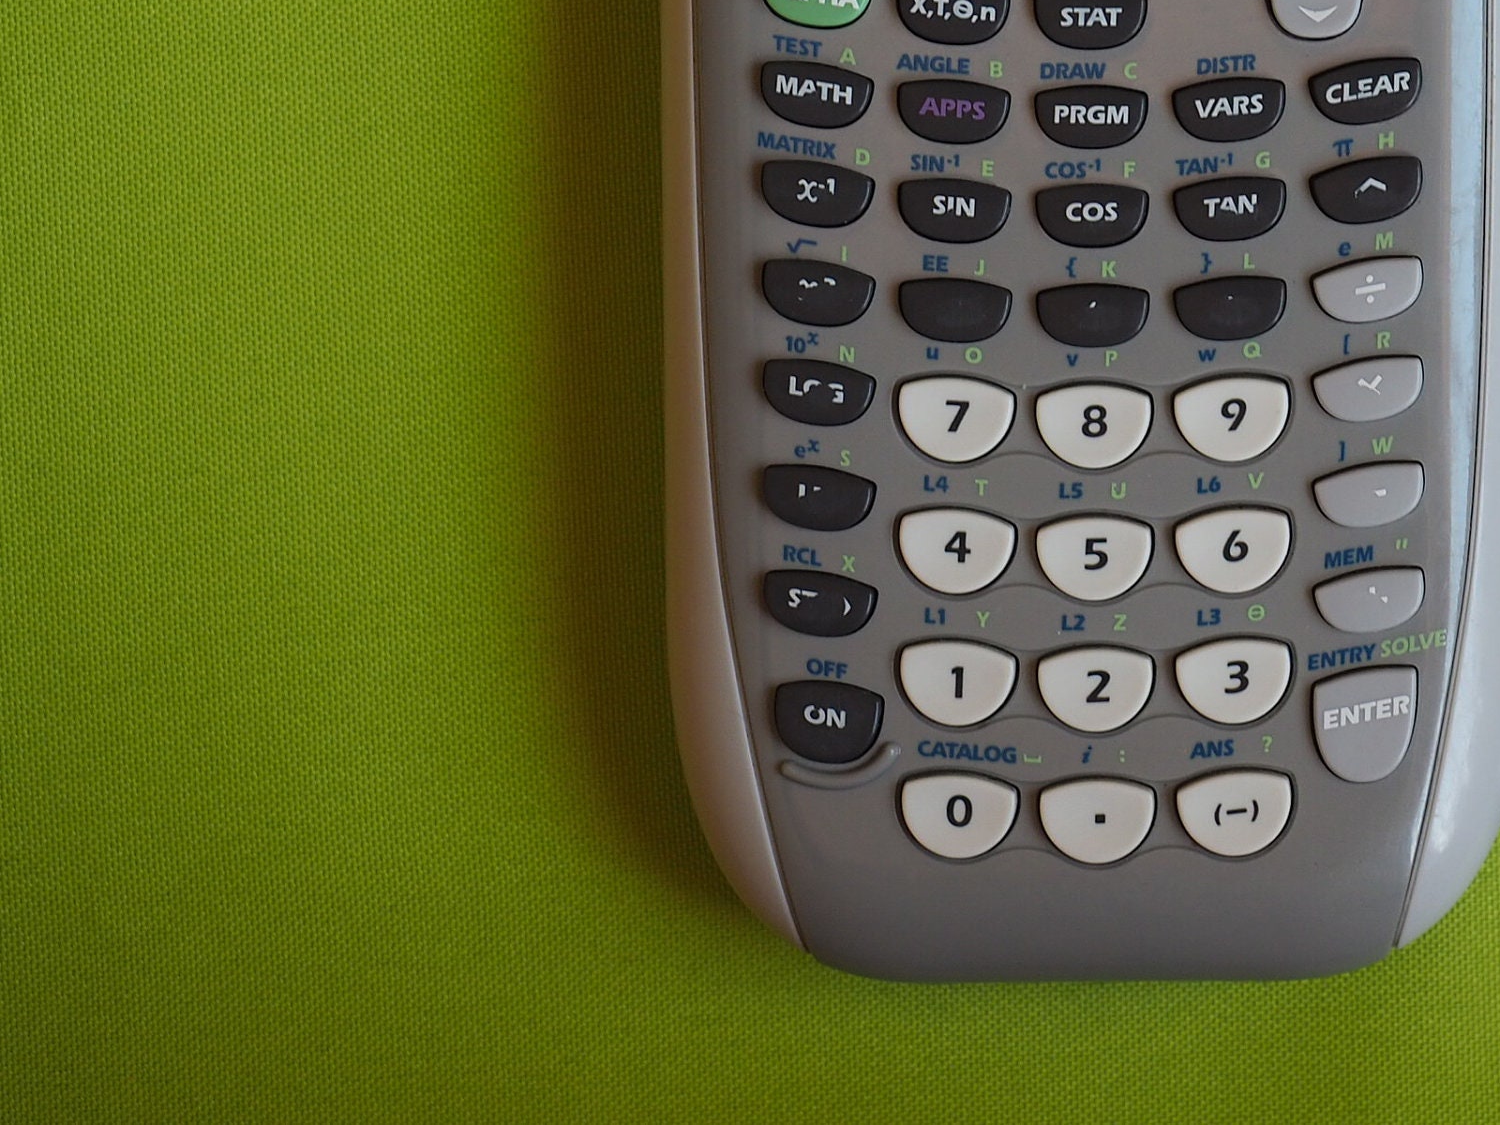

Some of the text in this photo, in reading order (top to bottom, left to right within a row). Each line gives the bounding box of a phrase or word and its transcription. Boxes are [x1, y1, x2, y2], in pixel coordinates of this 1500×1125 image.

[1060, 7, 1122, 27] STAT
[773, 35, 822, 57] TEST
[840, 48, 856, 65] A
[896, 53, 970, 75] ANGLE
[1197, 54, 1256, 75] DISTR
[990, 61, 1003, 78] B
[1040, 63, 1106, 79] DRAW
[1124, 63, 1137, 79] C
[776, 74, 853, 105] MATH
[1325, 71, 1411, 105] CLEAR
[919, 97, 986, 120] APPS
[1054, 105, 1129, 124] PRGM
[1194, 93, 1264, 119] VARS
[757, 131, 836, 159] MATRIX
[1378, 131, 1394, 150] H
[856, 149, 870, 165] D
[1255, 151, 1271, 169] G
[982, 160, 995, 177] E
[1124, 162, 1136, 178] F
[933, 195, 975, 217] SIN
[1065, 202, 1119, 223] COS
[1204, 193, 1257, 218] TAN
[1337, 242, 1351, 257] e
[1374, 232, 1394, 252] M
[923, 255, 949, 272] EE
[975, 259, 985, 276] J
[1102, 261, 1117, 277] K
[1244, 253, 1255, 270] L
[1377, 331, 1392, 350] R
[840, 345, 855, 363] N
[927, 347, 939, 361] u
[965, 347, 982, 364] O
[1105, 351, 1118, 367] P
[1243, 342, 1261, 360] Q
[945, 400, 970, 433] 7
[1081, 404, 1108, 438] 8
[1221, 398, 1247, 431] 9
[1372, 436, 1394, 455] W
[840, 450, 851, 467] S
[923, 475, 949, 492] L4
[975, 479, 988, 496] T
[1059, 482, 1083, 499] L5
[1111, 482, 1126, 499] U
[1197, 477, 1221, 495] L6
[1248, 473, 1264, 490] V
[783, 544, 822, 566] RCL
[945, 531, 971, 563] 4
[1084, 537, 1108, 570] 5
[1222, 529, 1249, 562] 6
[841, 555, 855, 572] X
[1324, 545, 1374, 568] MEM
[924, 607, 946, 624] L1
[976, 610, 990, 628] Y
[1061, 615, 1085, 631] L2
[1114, 614, 1126, 631] Z
[1197, 608, 1221, 626] L3
[1380, 629, 1447, 658] SOLVE
[1307, 643, 1376, 671] ENTRY
[806, 658, 848, 678] OFF
[1224, 660, 1249, 694] 3
[951, 666, 964, 699] 1
[1086, 670, 1111, 703] 2
[803, 704, 846, 729] ON
[1323, 695, 1410, 730] ENTER
[918, 739, 1017, 764] CATALOG
[1081, 745, 1092, 764] i
[1190, 739, 1234, 759] ANS
[946, 795, 972, 827] 0
